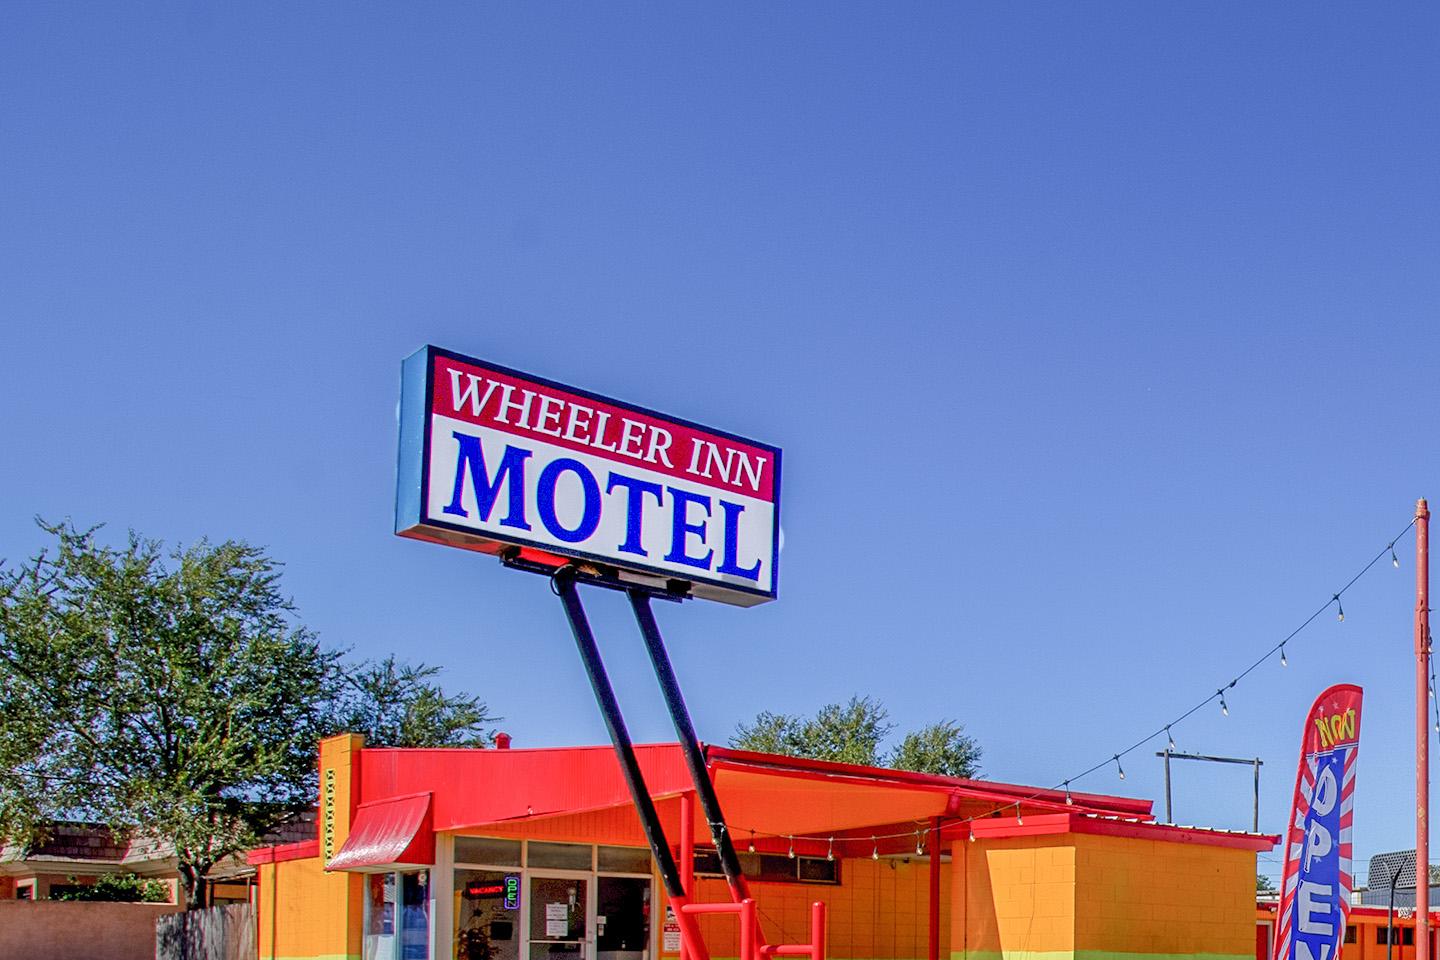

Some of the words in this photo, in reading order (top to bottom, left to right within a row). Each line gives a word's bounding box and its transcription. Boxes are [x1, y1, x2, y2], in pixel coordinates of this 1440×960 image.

[447, 368, 674, 468] WHEELER
[685, 438, 767, 491] INN
[442, 431, 762, 581] MOTEL
[1314, 709, 1356, 748] NOW
[506, 878, 518, 908] OPEN
